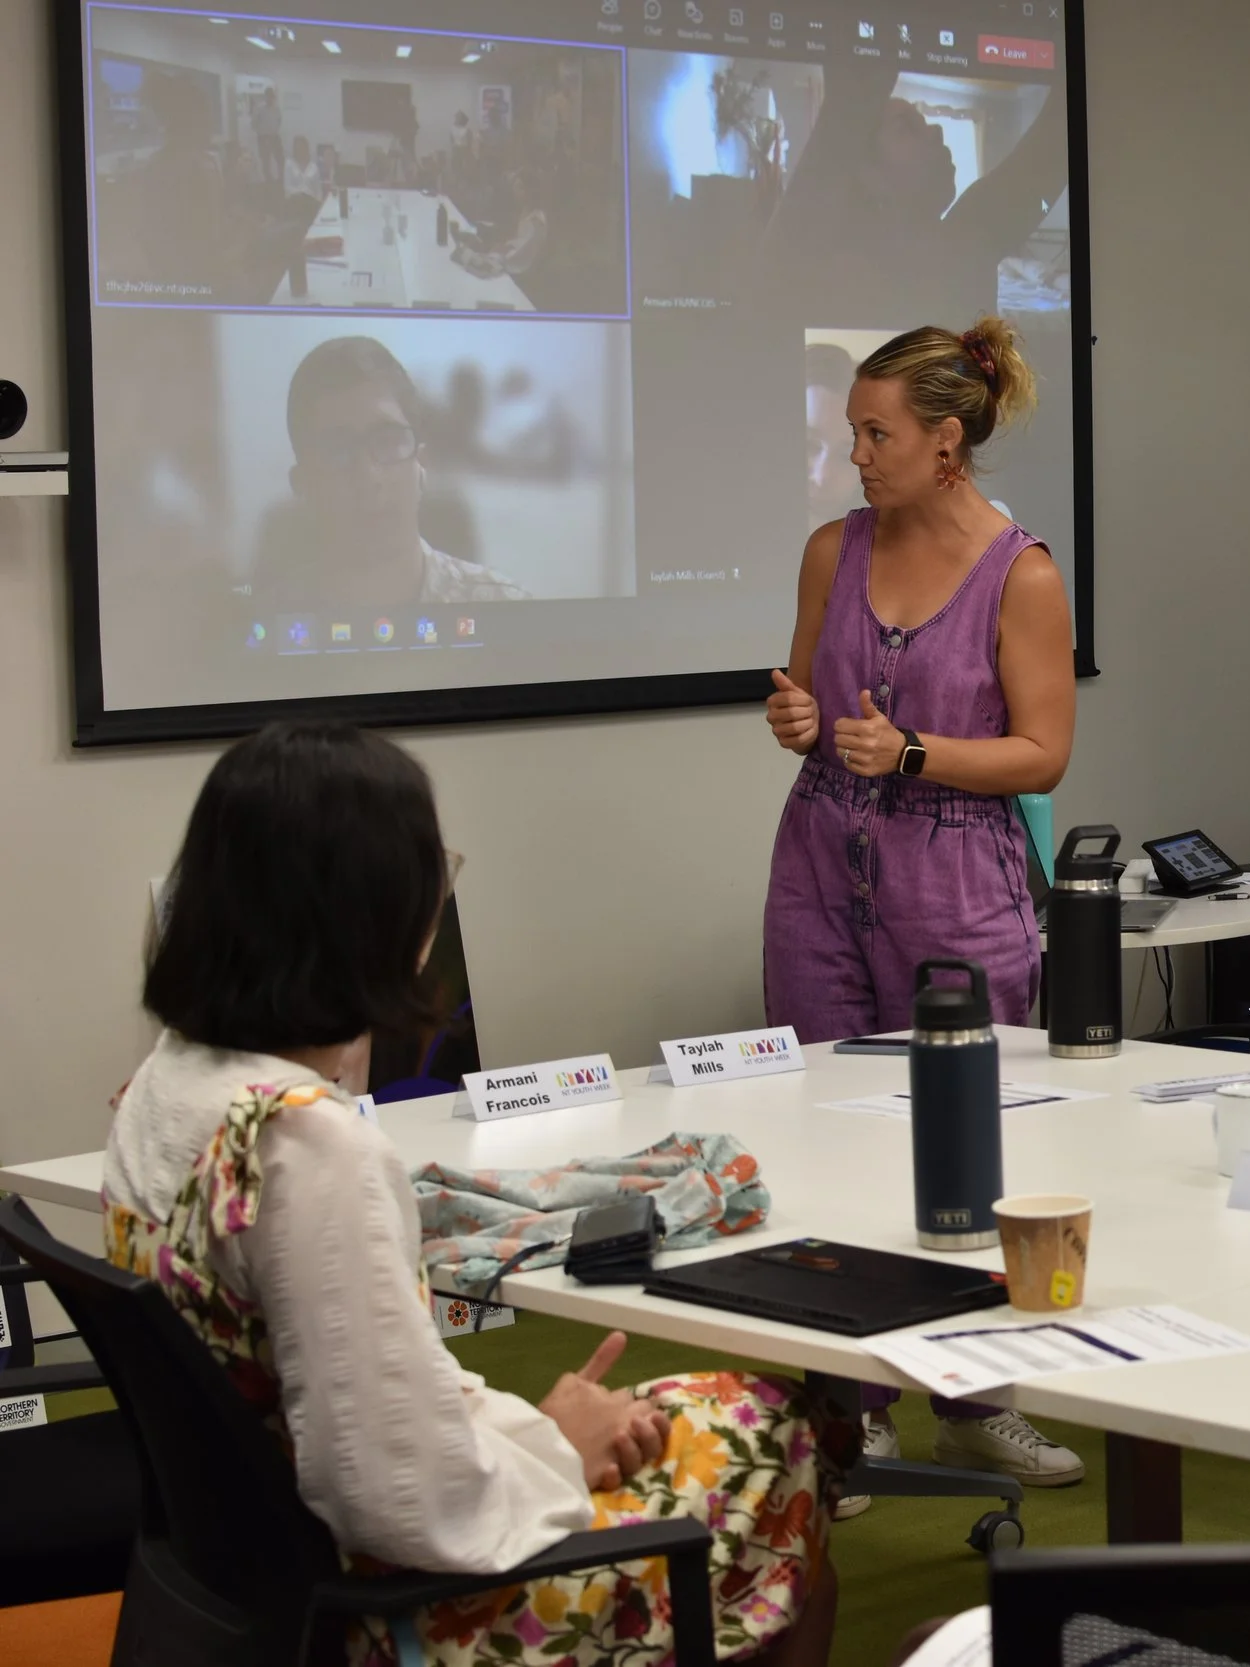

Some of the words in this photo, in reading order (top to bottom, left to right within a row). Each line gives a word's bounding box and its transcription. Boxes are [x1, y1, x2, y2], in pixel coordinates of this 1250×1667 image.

[854, 46, 880, 56] Camera
[1003, 47, 1027, 60] Leave
[926, 51, 942, 63] Stop
[944, 53, 968, 66] sharing
[1089, 1028, 1112, 1038] YETI
[678, 1040, 724, 1056] Taylah
[754, 1056, 773, 1064] YOUTH
[774, 1053, 791, 1062] WEEK
[692, 1062, 724, 1075] Mills
[486, 1071, 538, 1090] Armani
[571, 1086, 593, 1095] YOUTH
[594, 1083, 611, 1092] WEEK
[486, 1093, 551, 1112] Francois
[935, 1212, 967, 1225] YETI
[0, 1398, 38, 1413] ORTHERN
[0, 1408, 34, 1422] ERRITORY
[0, 1417, 33, 1428] OVERNMENT
